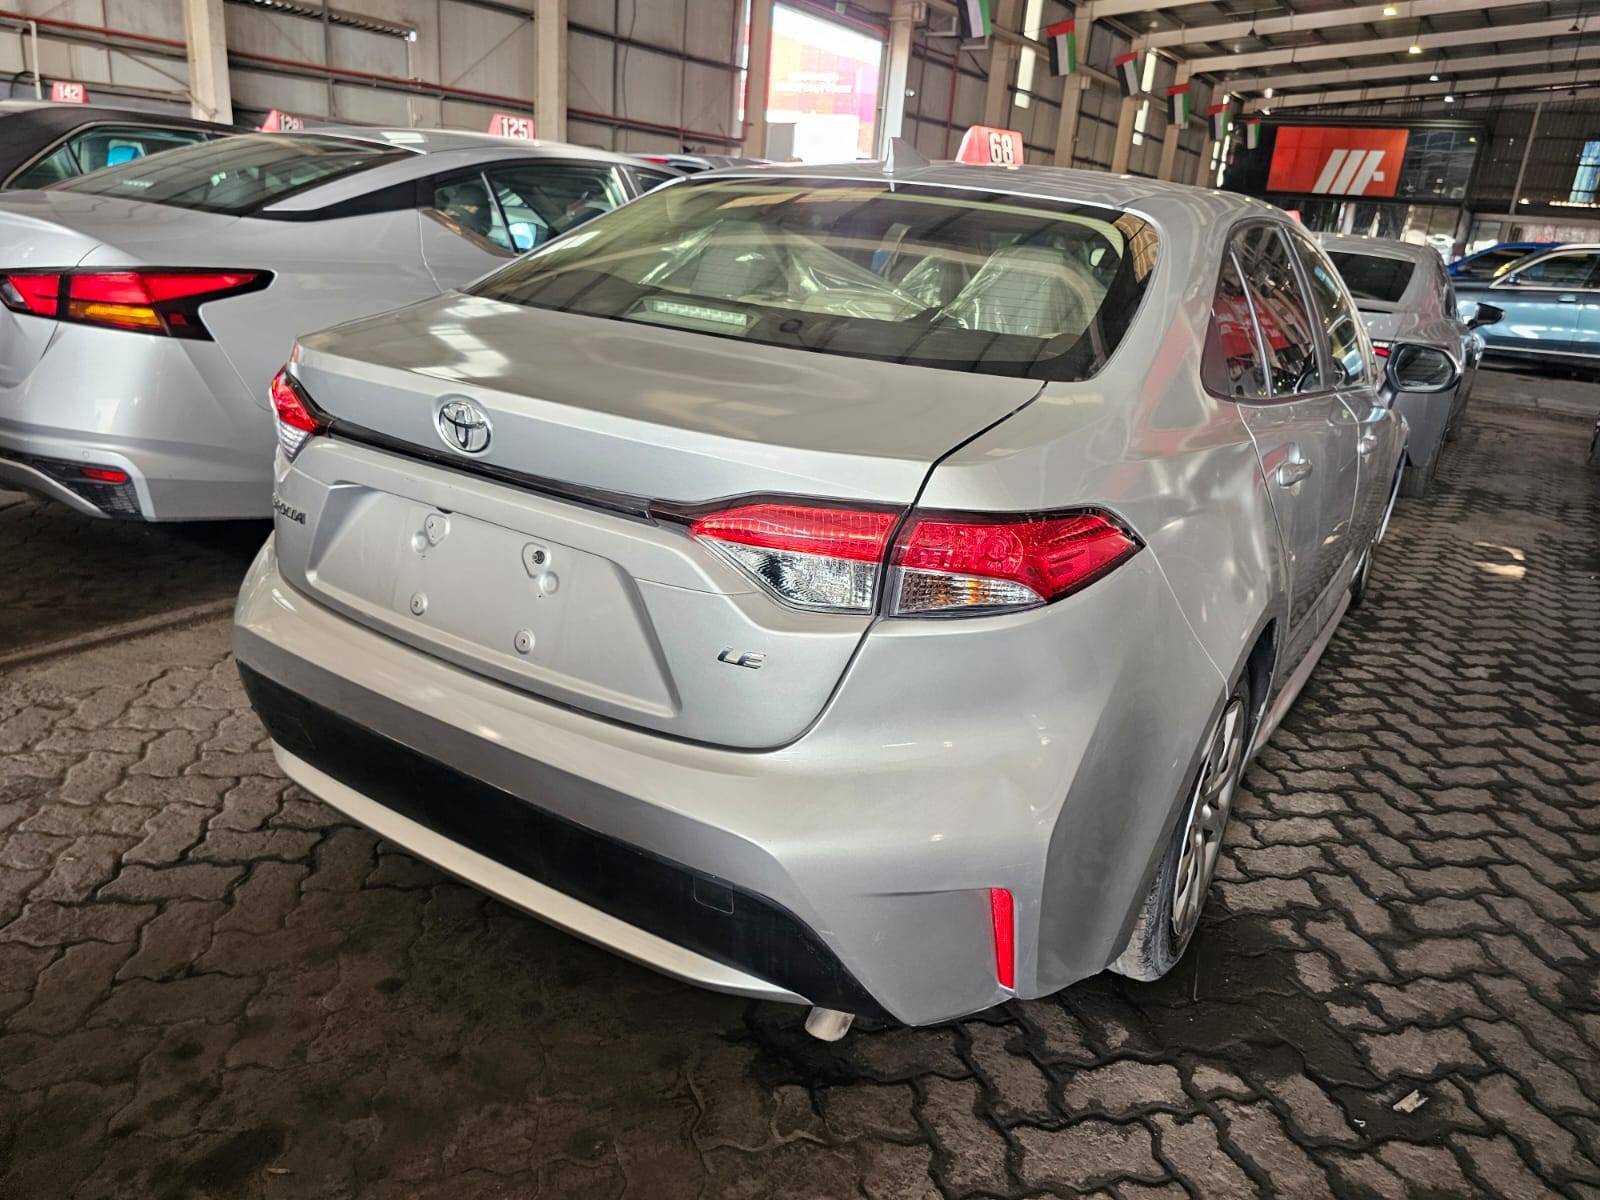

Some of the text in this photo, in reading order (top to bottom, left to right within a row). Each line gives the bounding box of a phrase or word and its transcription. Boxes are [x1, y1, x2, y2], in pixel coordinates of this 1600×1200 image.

[58, 84, 79, 100] 142
[501, 117, 528, 139] 125
[989, 132, 1014, 164] 68
[717, 646, 767, 670] LE
